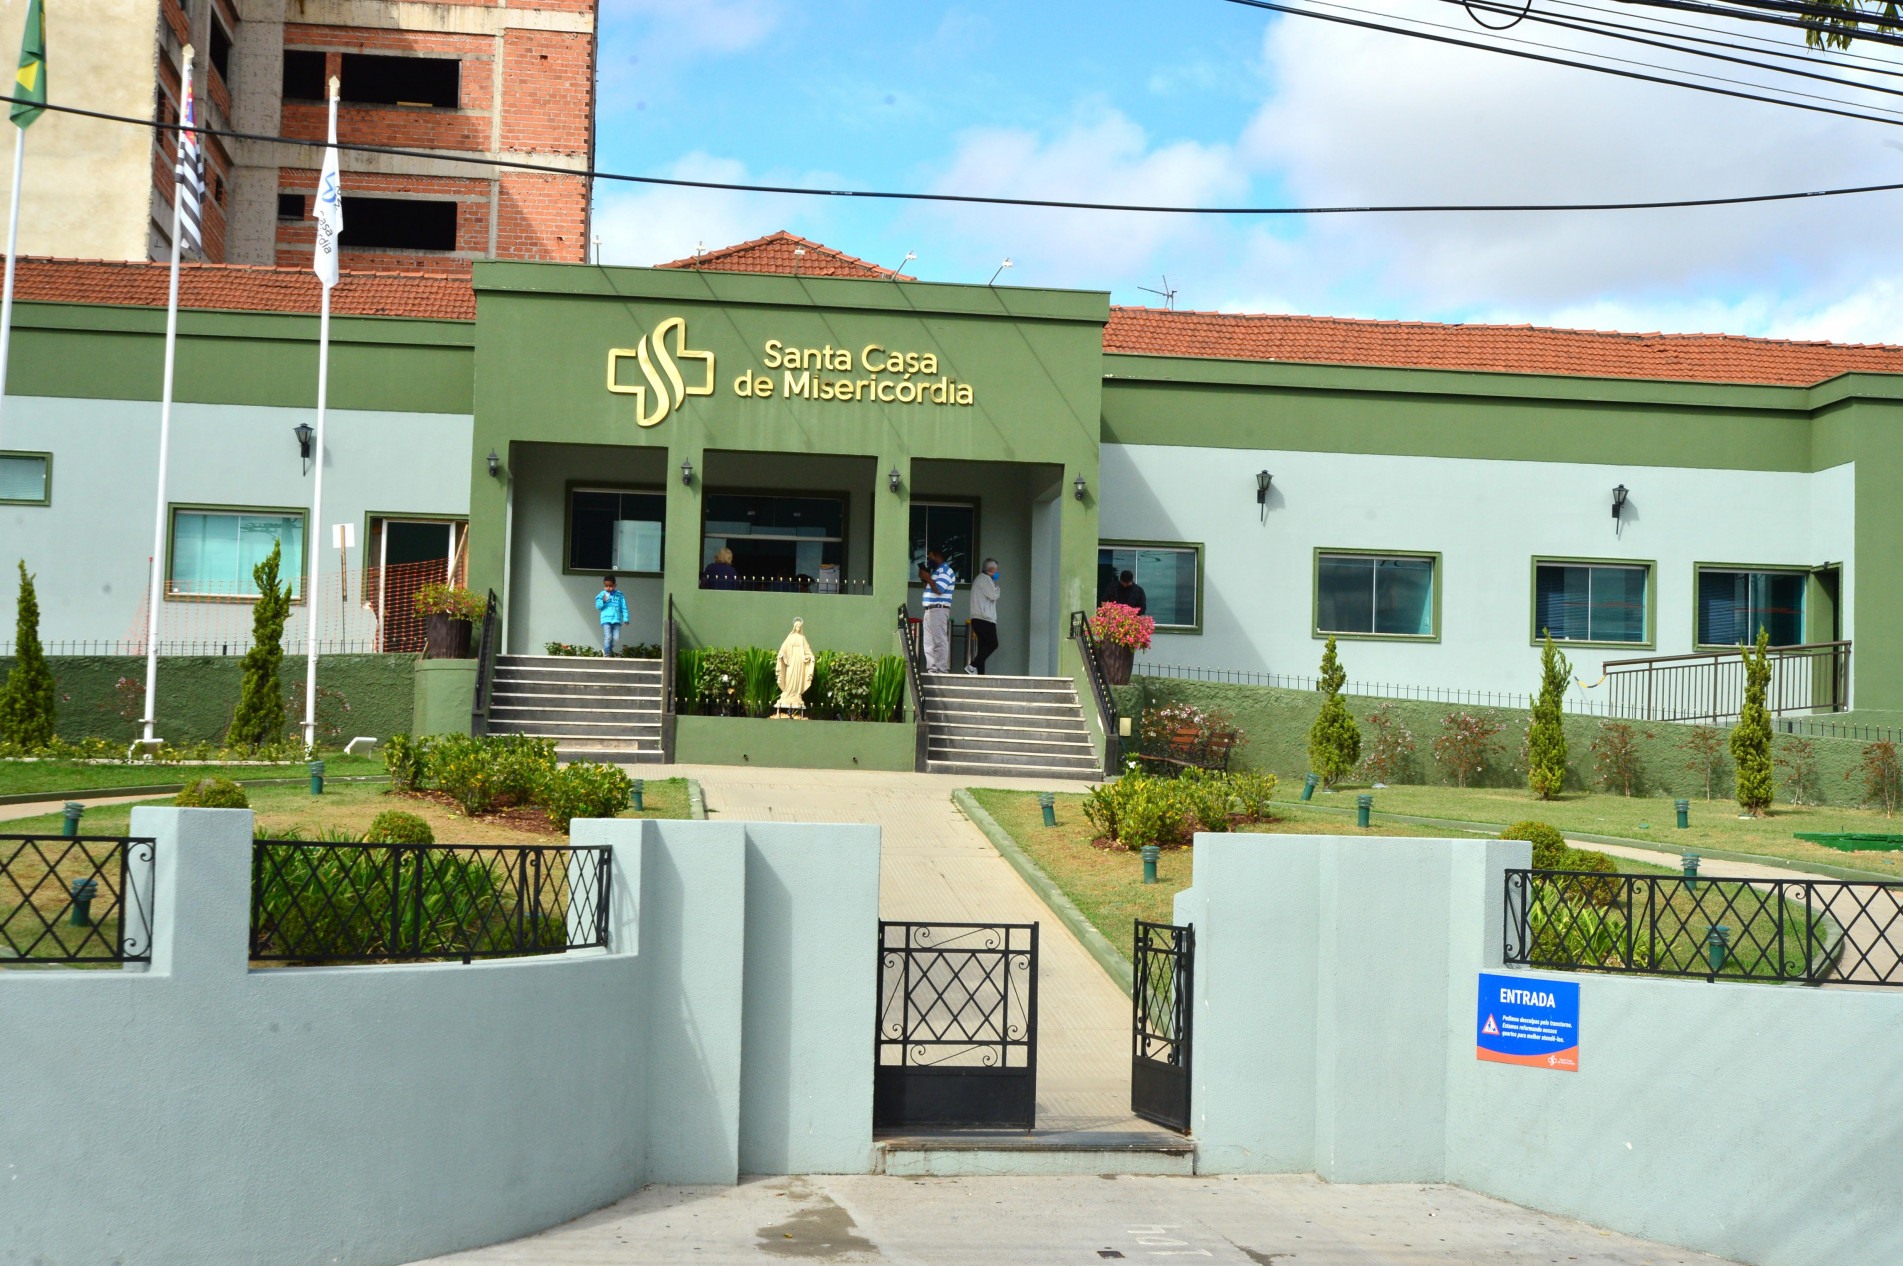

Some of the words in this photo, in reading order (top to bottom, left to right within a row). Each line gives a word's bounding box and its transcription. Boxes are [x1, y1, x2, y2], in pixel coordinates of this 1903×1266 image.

[763, 339, 853, 371] Santa
[860, 343, 939, 375] Casa
[733, 369, 774, 398] de
[783, 370, 974, 406] Misericórdia
[1500, 988, 1556, 1008] ENTRADA
[1519, 1017, 1540, 1025] desculpas
